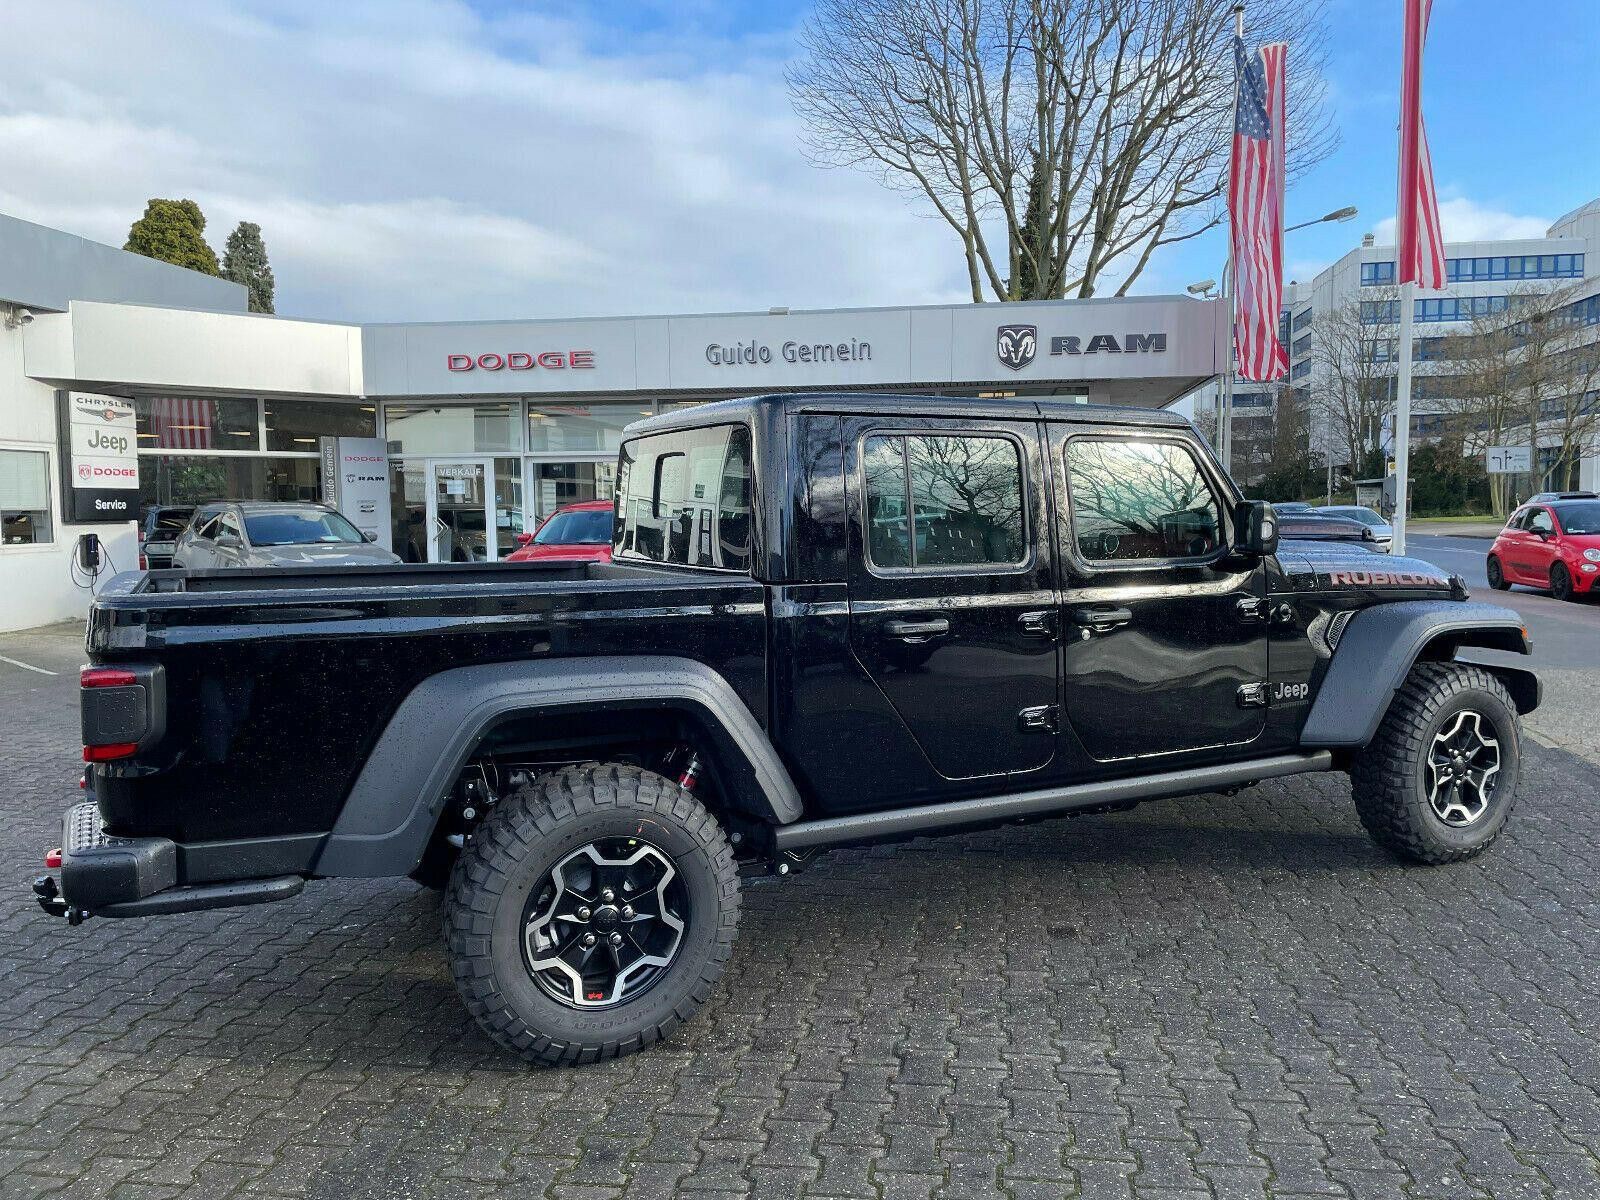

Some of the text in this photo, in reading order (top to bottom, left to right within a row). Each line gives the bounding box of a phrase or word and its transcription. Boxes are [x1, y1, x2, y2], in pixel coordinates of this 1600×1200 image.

[705, 337, 872, 365] Guido Gemein
[1050, 333, 1167, 355] RAM
[447, 350, 595, 372] DODGE
[76, 397, 132, 409] CHRYSLER
[88, 429, 128, 454] Jeep
[326, 445, 335, 476] Gemein
[94, 467, 136, 477] DODGE
[440, 468, 481, 476] VERKAUF
[95, 499, 127, 510] Service
[1329, 571, 1449, 586] RUBICON
[1274, 682, 1309, 700] Jeep
